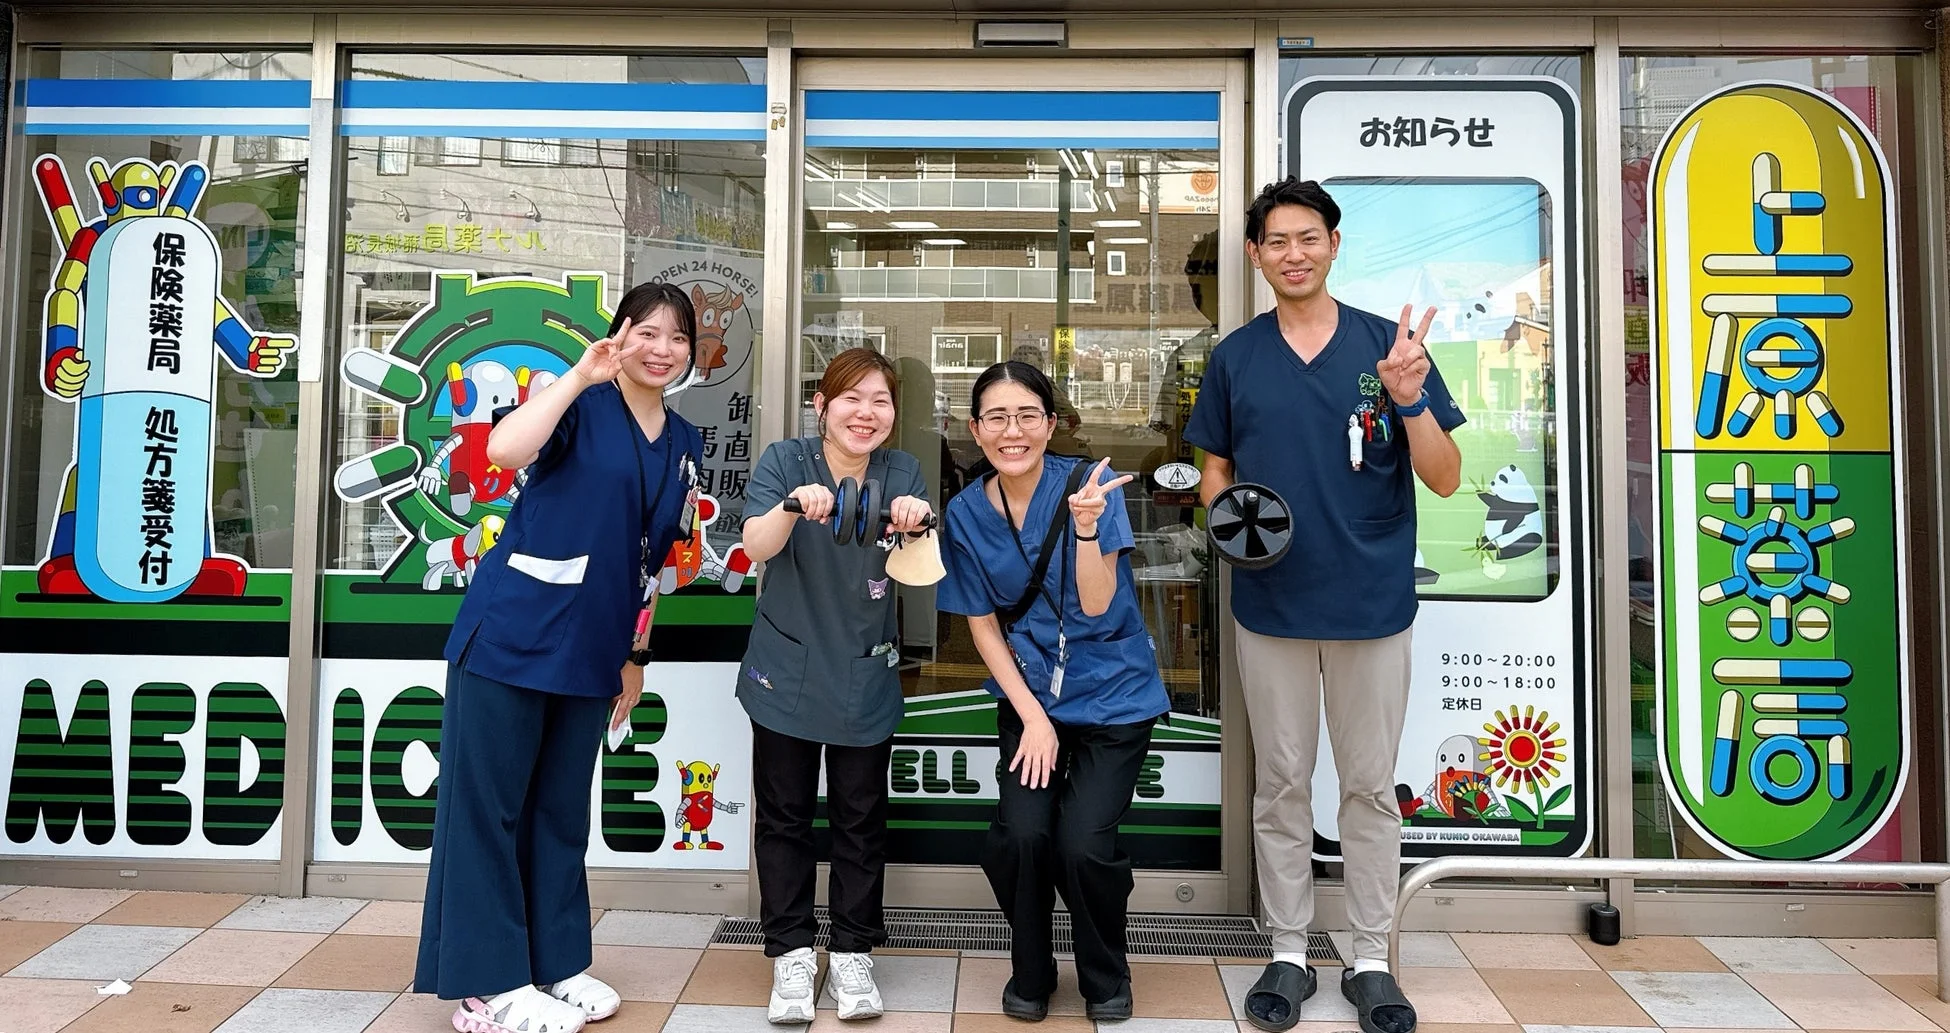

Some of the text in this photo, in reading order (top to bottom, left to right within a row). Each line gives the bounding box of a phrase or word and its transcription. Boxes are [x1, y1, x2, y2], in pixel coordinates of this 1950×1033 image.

[1360, 116, 1495, 148] お知らせ
[652, 260, 758, 299] OPEN 24 HORSE!
[147, 231, 186, 375] 保険薬局
[138, 405, 180, 586] 処方箋受付
[1442, 697, 1482, 711] 定休日
[891, 749, 980, 794] ELL
[1426, 832, 1438, 841] BY
[1439, 833, 1470, 841] KUNIO
[1472, 833, 1520, 842] OKAWARA
